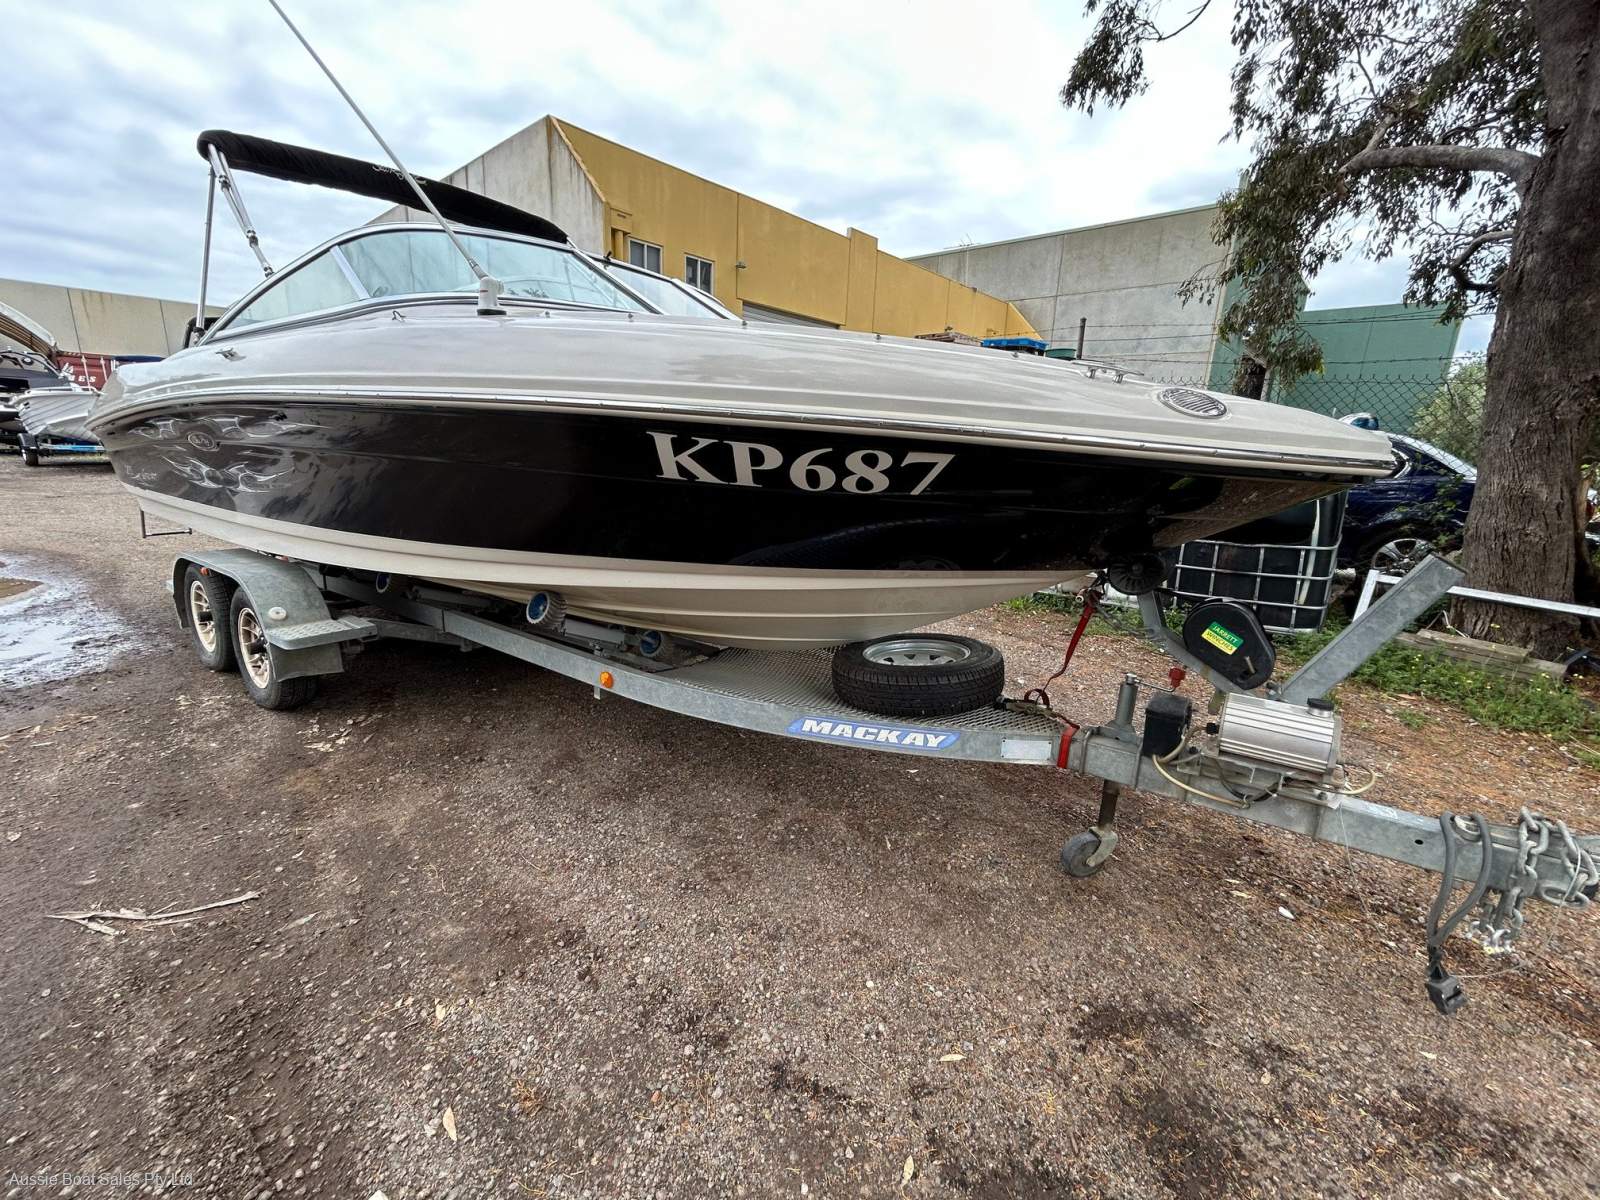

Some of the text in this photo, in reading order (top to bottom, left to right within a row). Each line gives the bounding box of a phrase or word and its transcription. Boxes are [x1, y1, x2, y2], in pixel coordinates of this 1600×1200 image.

[646, 431, 956, 495] KP687
[1206, 631, 1233, 651] WINCHES
[1212, 625, 1238, 643] JARRETT
[801, 719, 947, 748] MACKAY
